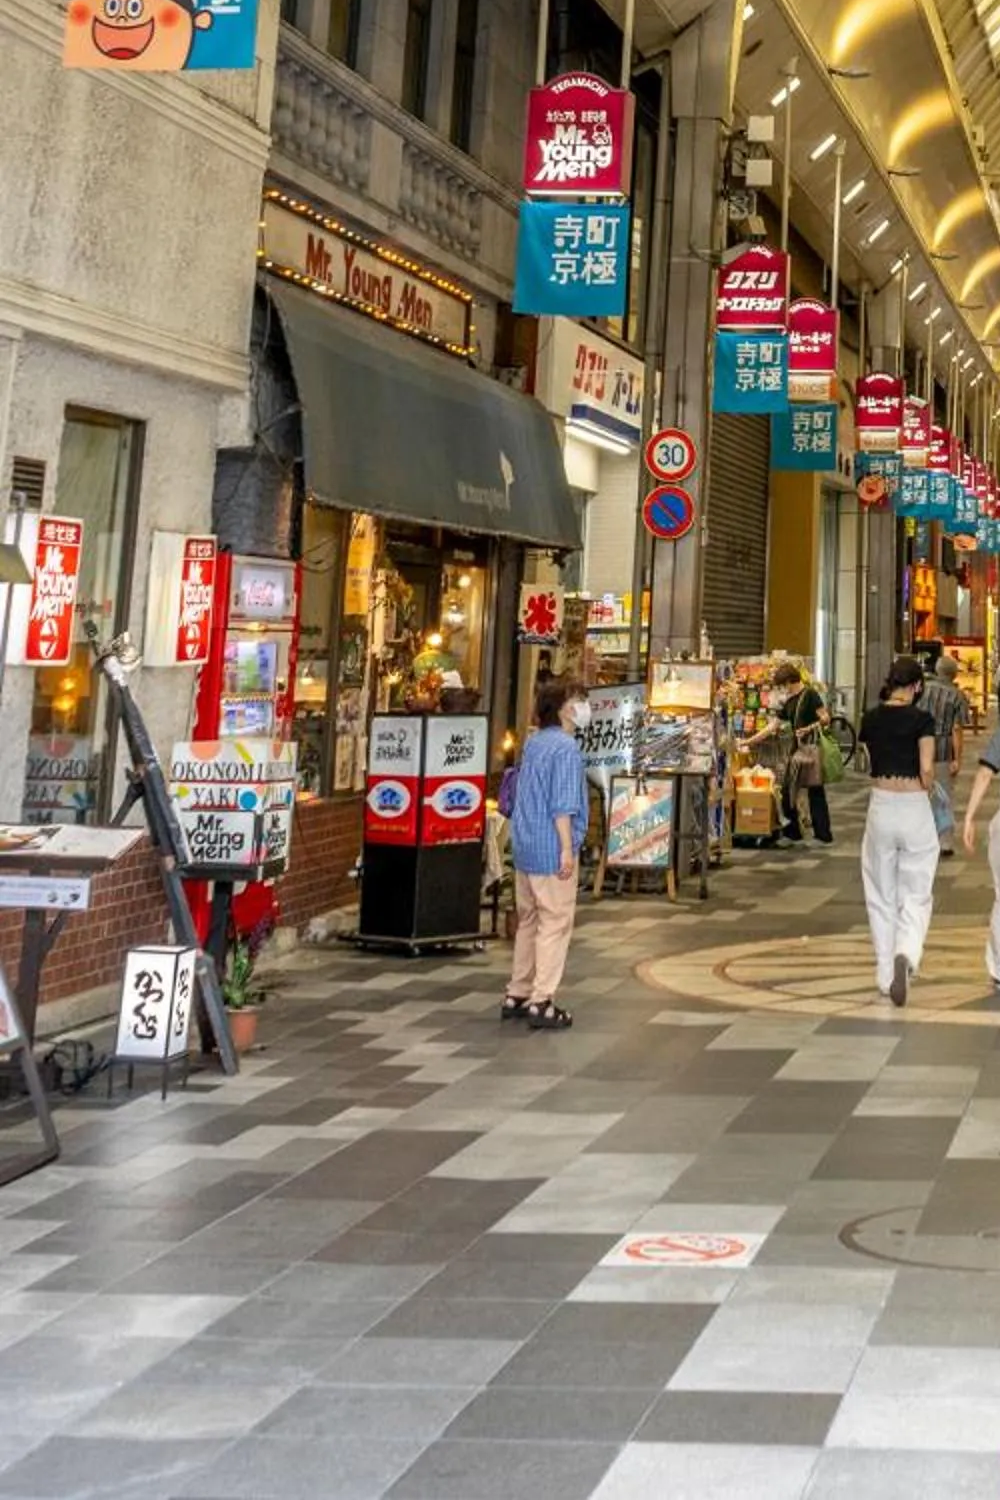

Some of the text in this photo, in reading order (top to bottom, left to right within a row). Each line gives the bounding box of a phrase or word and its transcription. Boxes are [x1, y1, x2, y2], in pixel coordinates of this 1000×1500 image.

[538, 139, 613, 169] Young
[533, 160, 597, 182] Men
[554, 214, 621, 249] 寺町
[550, 250, 618, 286] 京極
[723, 271, 779, 290] クスリ
[306, 233, 433, 330] Mr. Young Men
[736, 341, 784, 366] 寺町
[735, 367, 784, 392] 京極
[656, 442, 686, 468] 30
[172, 761, 263, 780] OKONOMI
[185, 827, 245, 851] Young
